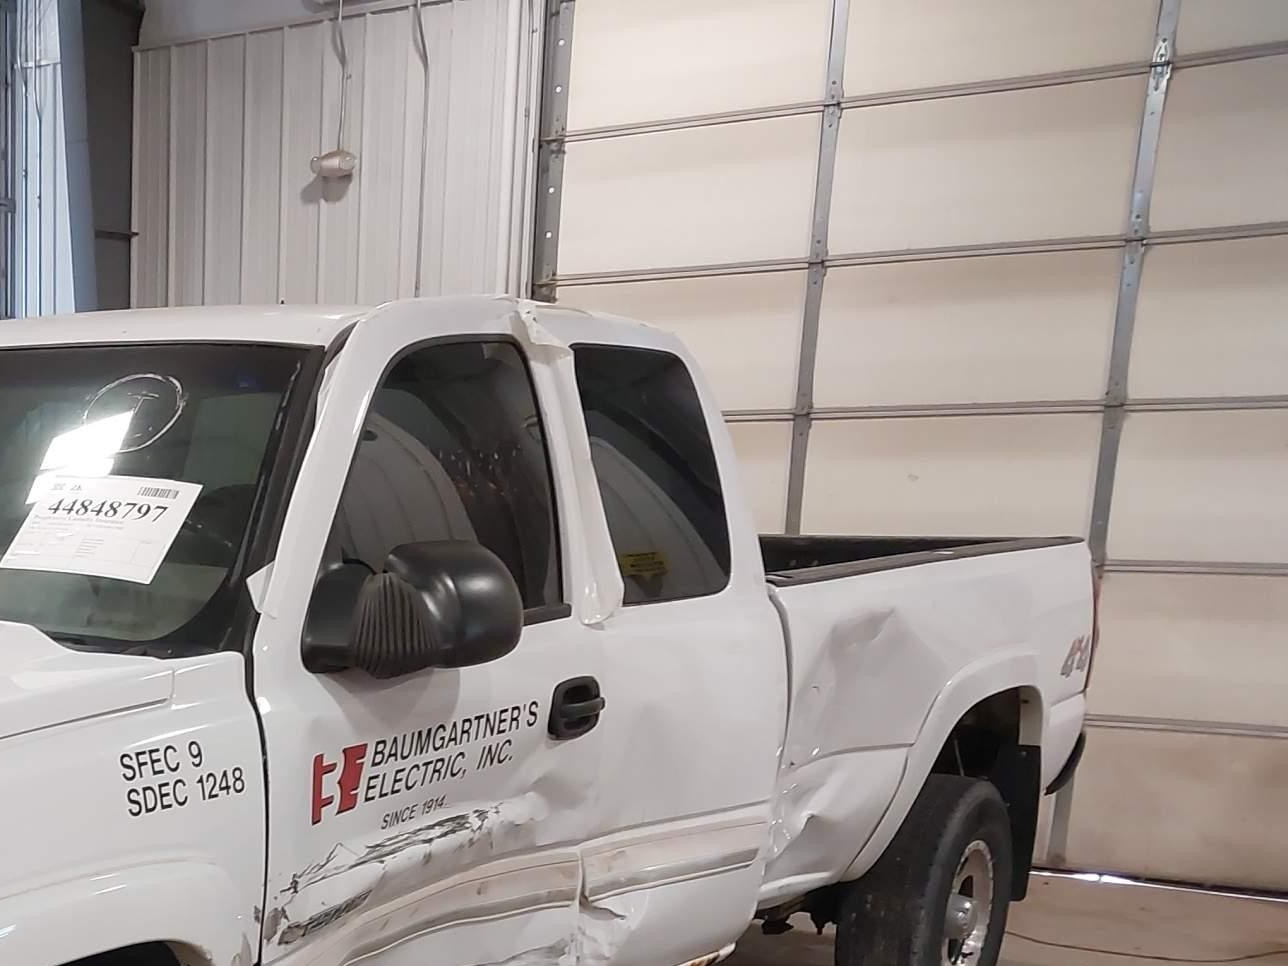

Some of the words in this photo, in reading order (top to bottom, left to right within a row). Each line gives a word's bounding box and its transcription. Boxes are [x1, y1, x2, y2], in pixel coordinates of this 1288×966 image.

[48, 497, 169, 523] 44848797
[370, 700, 538, 768] BAUMGARTNER'S
[119, 744, 181, 782] SFEC
[188, 740, 203, 768] 9
[364, 751, 468, 803] ELECTRIC,
[476, 738, 514, 771] INC.
[126, 778, 189, 817] SDEC
[196, 766, 246, 801] 1248
[380, 803, 417, 830] SINCE
